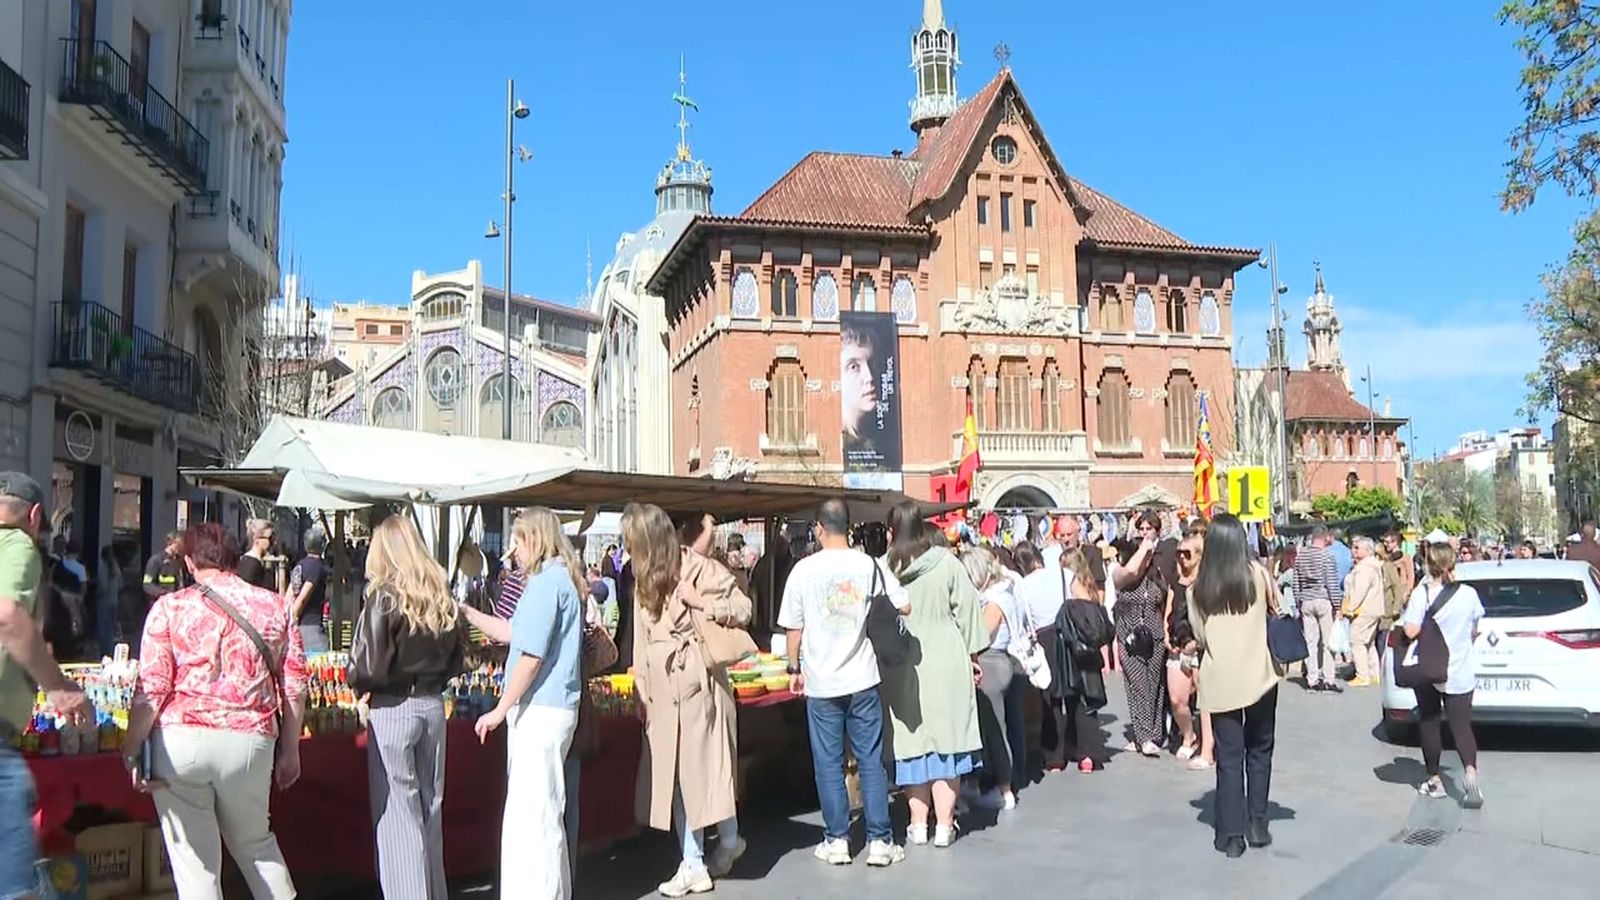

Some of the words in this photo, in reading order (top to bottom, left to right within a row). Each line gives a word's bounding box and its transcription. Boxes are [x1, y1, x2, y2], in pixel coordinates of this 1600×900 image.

[877, 420, 884, 430] LA
[1474, 679, 1499, 691] 461
[1505, 679, 1531, 691] JXR
